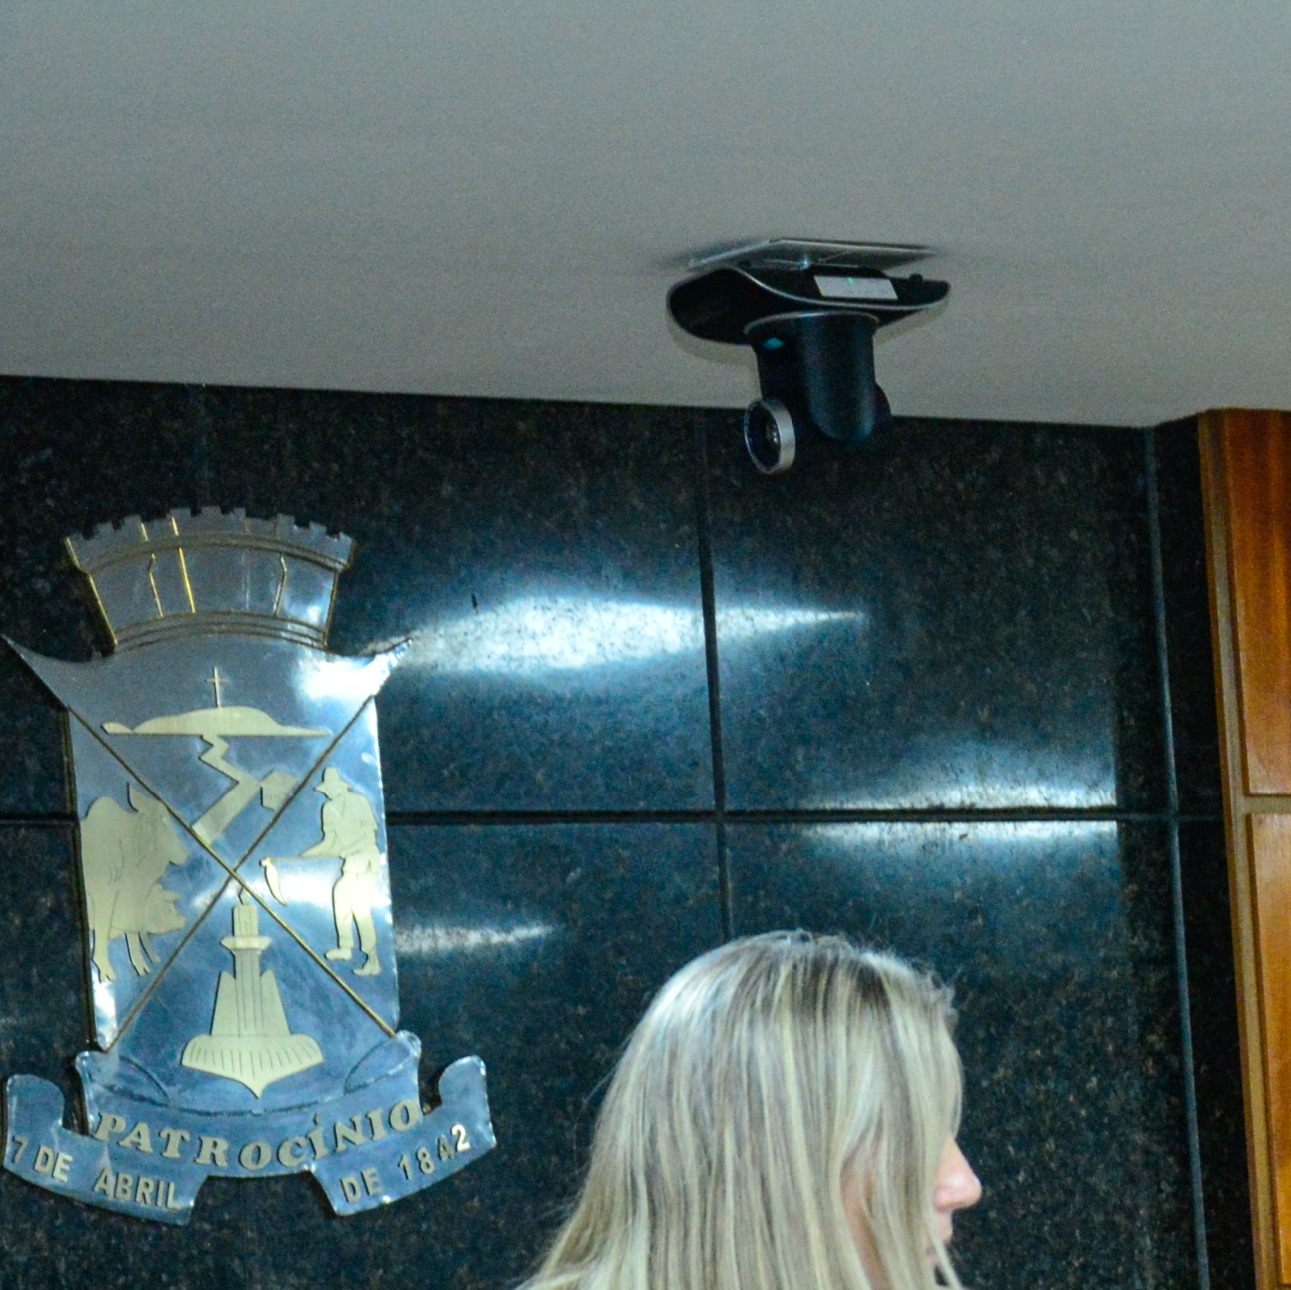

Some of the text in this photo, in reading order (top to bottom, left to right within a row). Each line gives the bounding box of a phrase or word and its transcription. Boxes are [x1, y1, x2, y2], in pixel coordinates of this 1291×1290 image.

[12, 1134, 182, 1210] 7 DE ABRIL
[94, 1099, 425, 1171] PATROCÍNIO
[340, 1123, 472, 1203] DE 1842
